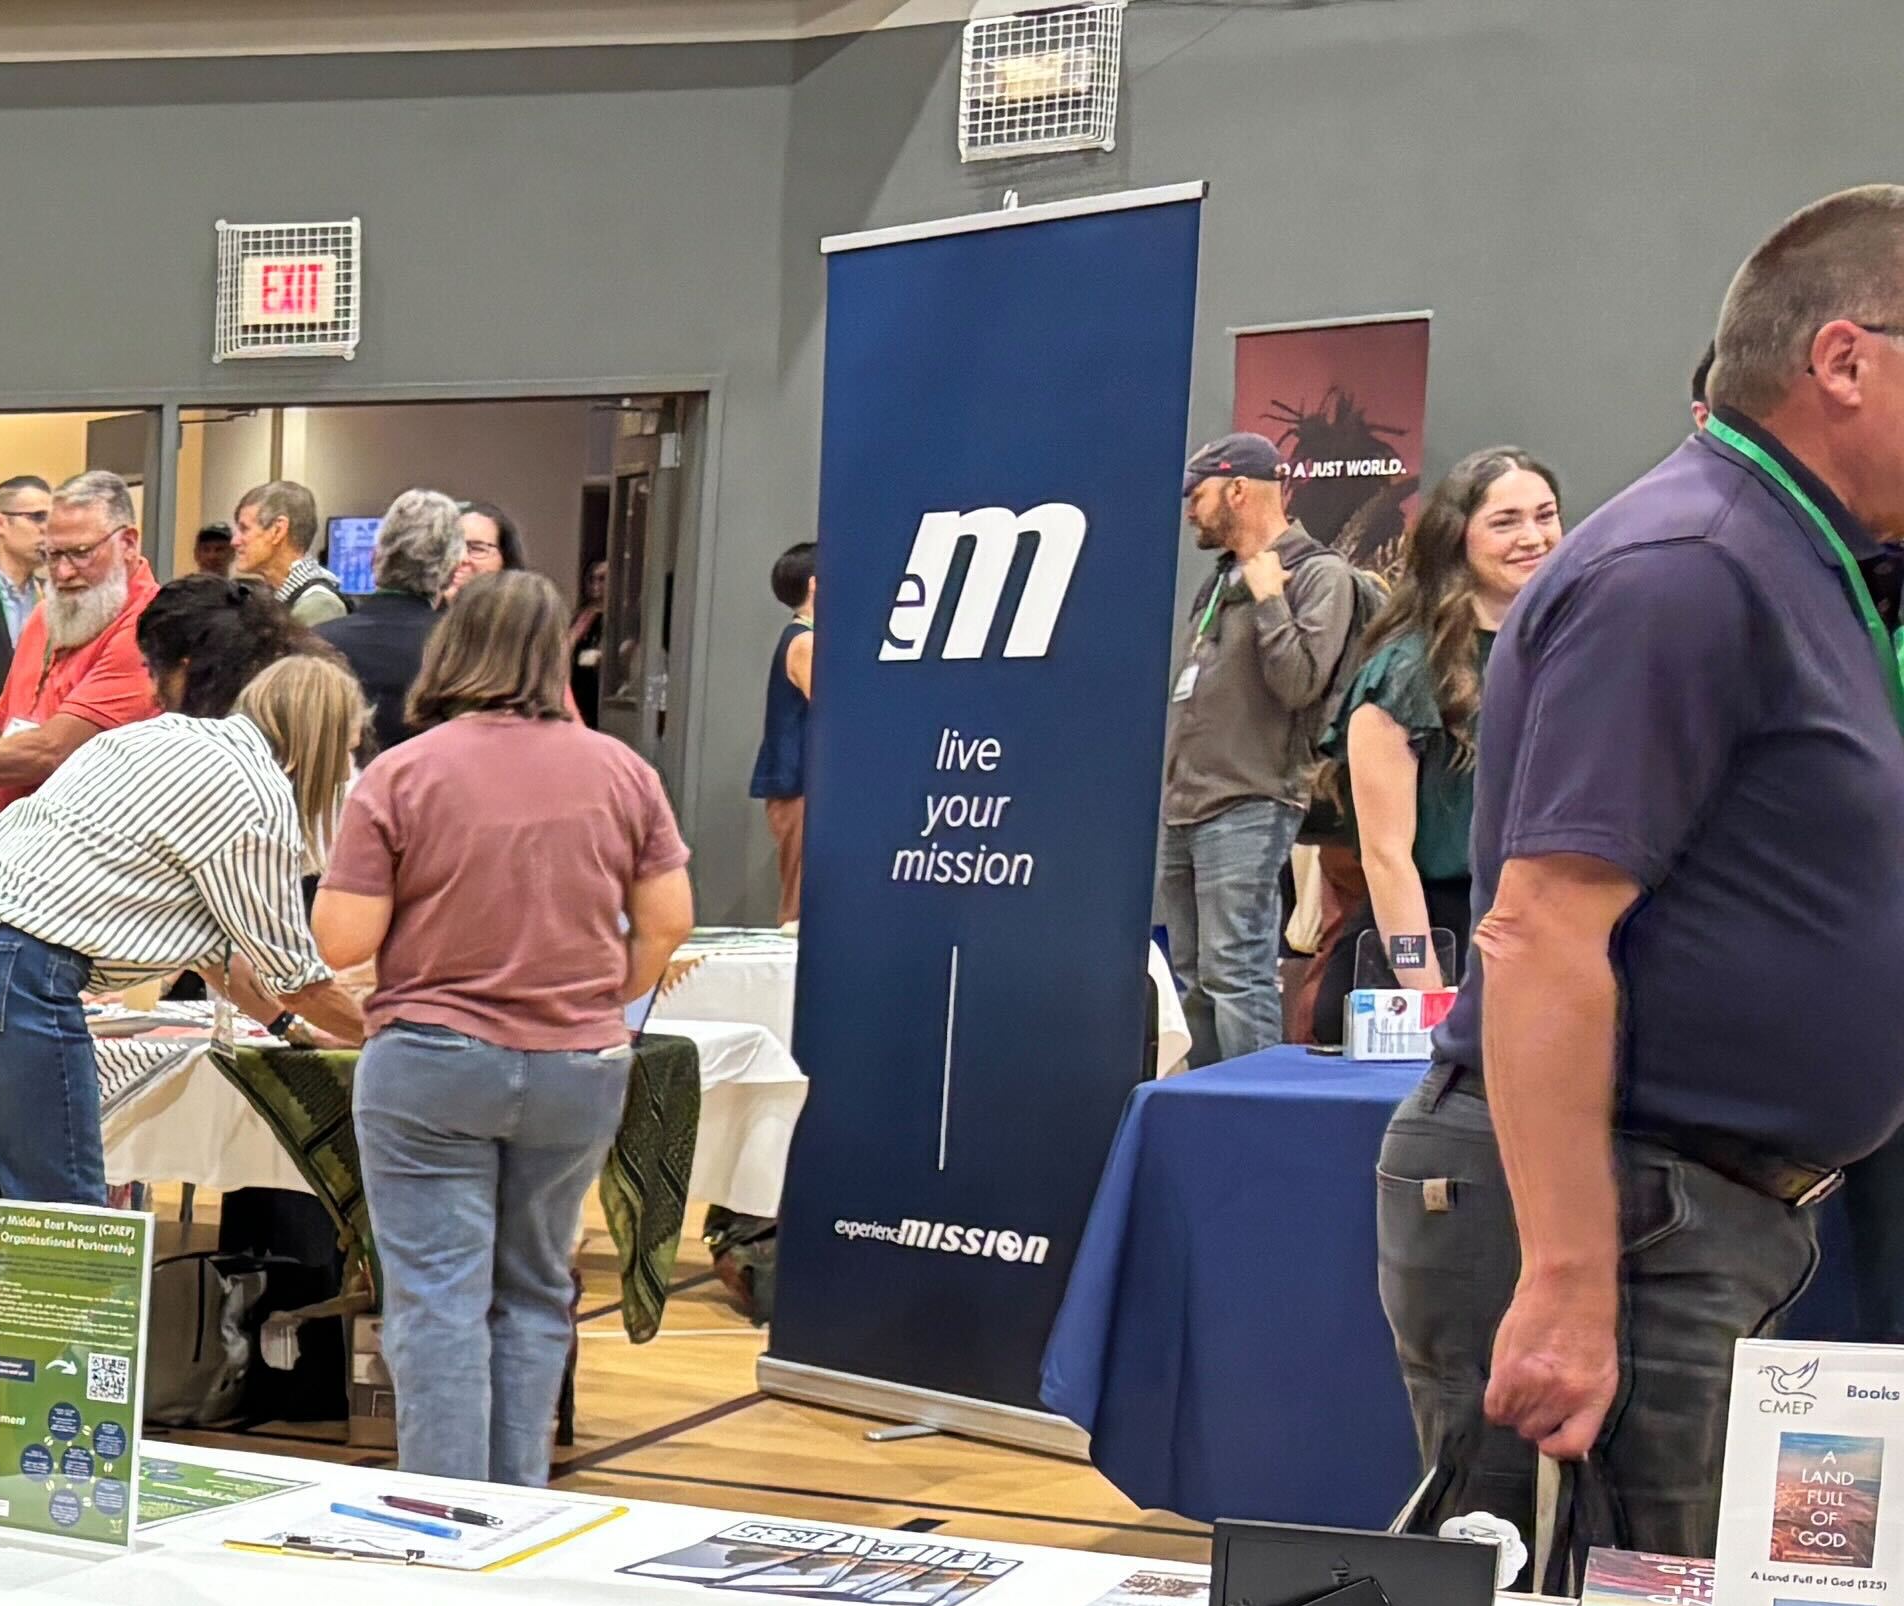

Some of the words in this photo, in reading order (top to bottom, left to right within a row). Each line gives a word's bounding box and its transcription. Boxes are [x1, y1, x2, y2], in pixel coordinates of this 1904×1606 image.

[262, 264, 323, 314] EXIT
[1293, 464, 1307, 478] A
[1308, 460, 1343, 478] JUST
[1346, 458, 1408, 477] WORLD.
[936, 727, 1002, 772] live
[920, 794, 1012, 837] your
[892, 842, 1034, 887] mission
[7, 1215, 42, 1229] Middle
[77, 1237, 137, 1257] Partnership
[1847, 1384, 1901, 1401] Books
[1758, 1398, 1815, 1416] CMEP
[1822, 1450, 1838, 1465] A
[1801, 1468, 1856, 1487] LAND
[1806, 1489, 1846, 1507] FULL
[1810, 1510, 1842, 1527] OF
[1797, 1529, 1848, 1548] GOD
[1750, 1570, 1760, 1580] A
[1762, 1572, 1790, 1583] Land
[1830, 1577, 1855, 1588] God
